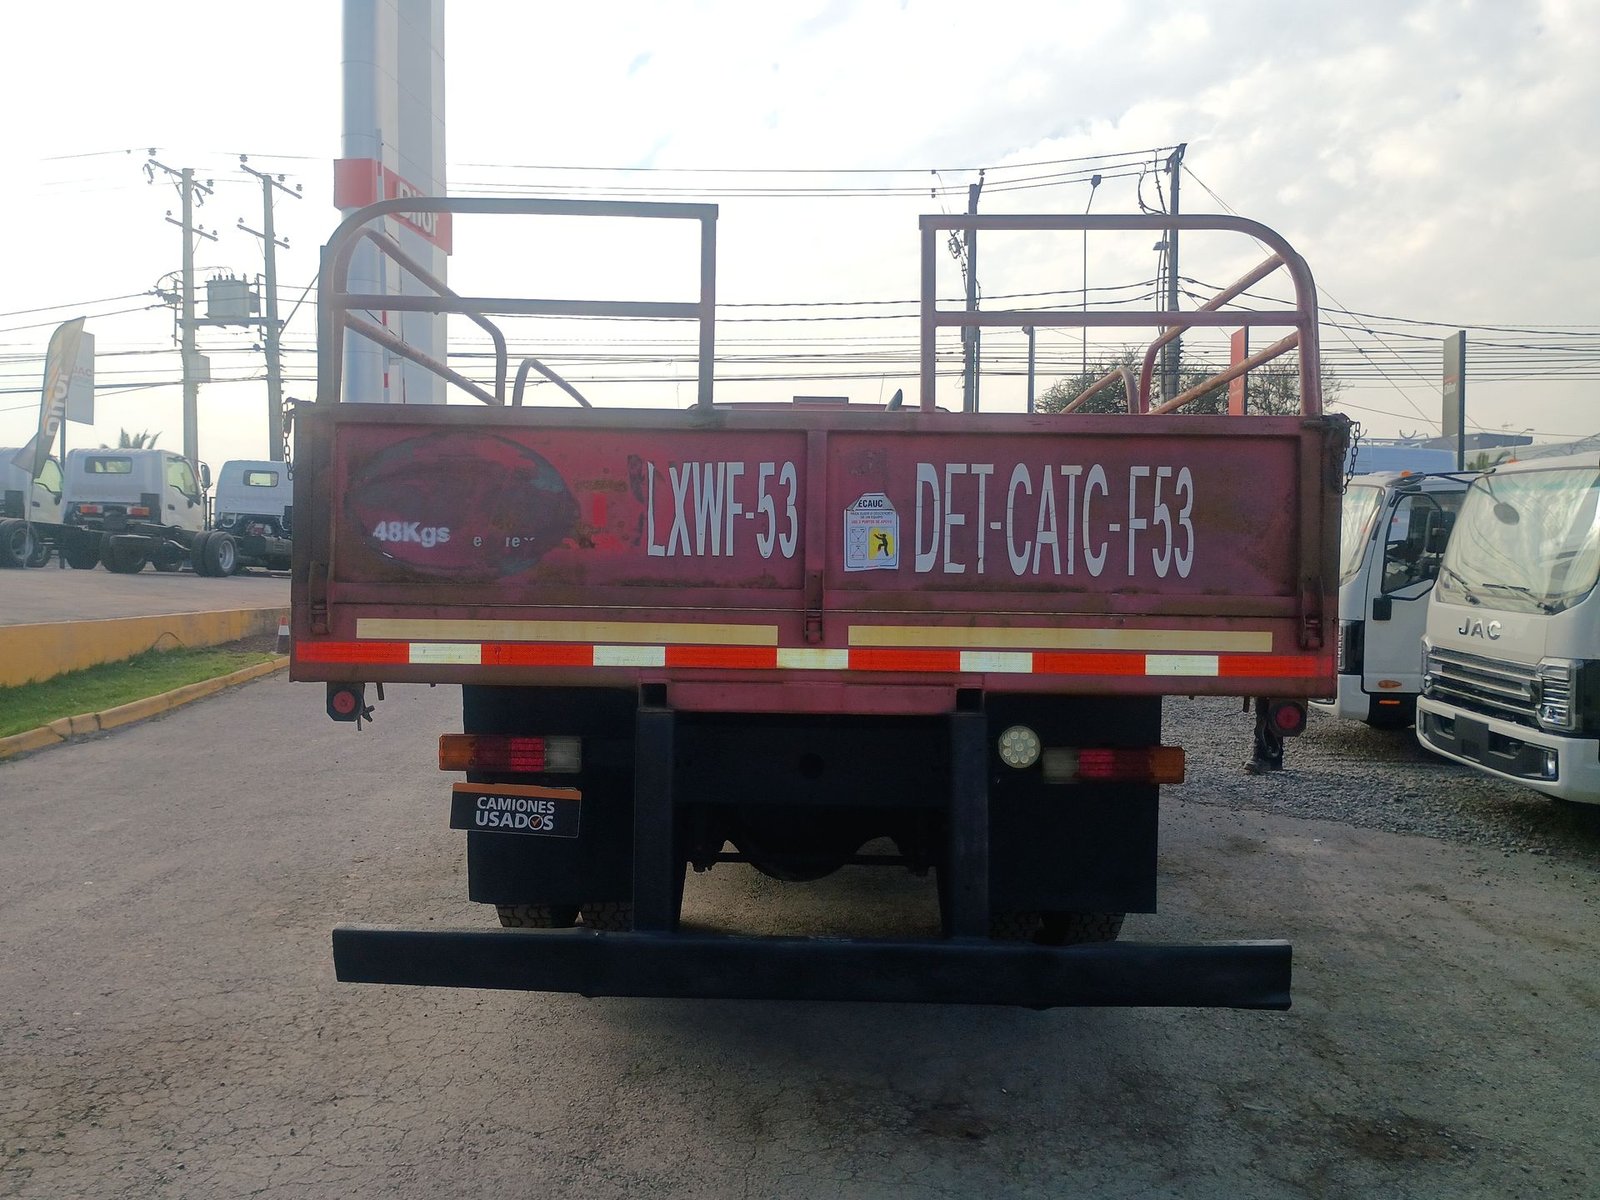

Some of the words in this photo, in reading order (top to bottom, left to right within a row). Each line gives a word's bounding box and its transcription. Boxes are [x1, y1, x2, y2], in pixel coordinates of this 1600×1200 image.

[647, 461, 798, 558] LXWF-53
[915, 462, 1194, 578] DET-CATC-F53
[1458, 616, 1502, 640] JAC
[477, 797, 555, 814] CAMIONES
[475, 811, 554, 831] USADOS
